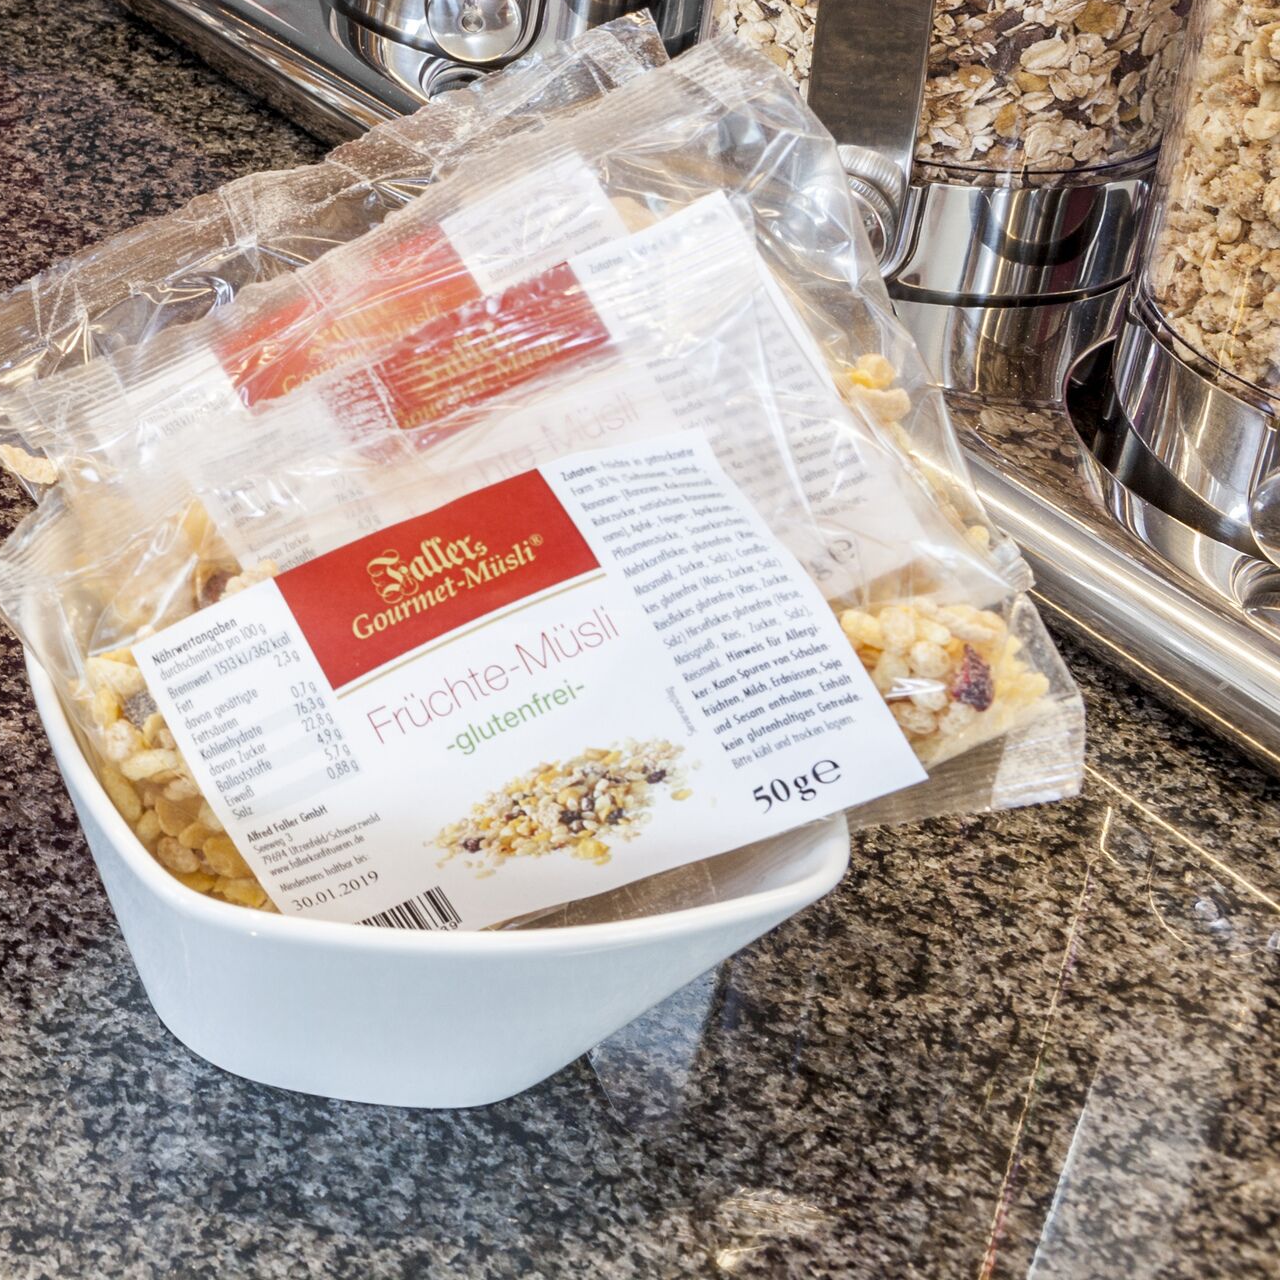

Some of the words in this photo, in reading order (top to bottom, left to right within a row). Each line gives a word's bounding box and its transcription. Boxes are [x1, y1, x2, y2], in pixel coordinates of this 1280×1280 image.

[366, 534, 489, 605] Fallers
[151, 619, 237, 666] Nährwertangaben
[160, 639, 225, 681] durchschnittlich
[224, 635, 241, 651] pro
[239, 623, 258, 640] 100
[725, 643, 765, 662] Hinweis
[765, 636, 781, 647] für
[273, 650, 292, 668] 2,3
[711, 675, 738, 691] Kann
[736, 661, 771, 680] Spuren
[772, 655, 790, 666] von
[167, 670, 213, 700] Brennwert
[214, 656, 238, 676] 1513
[290, 681, 306, 699] 0,7
[366, 606, 620, 744] Früchte-Müsli
[701, 695, 744, 717] früchten,
[742, 682, 768, 698] Milch,
[819, 659, 843, 671] Soja
[175, 699, 194, 714] Fett
[184, 711, 212, 730] davon
[293, 697, 317, 716] 76,3
[446, 678, 587, 757] -glutenfrei-
[713, 718, 732, 735] und
[732, 706, 766, 725] Sesam
[190, 718, 239, 745] Fettsäuren
[301, 712, 325, 733] 22,8
[317, 728, 332, 744] 4,9
[721, 737, 744, 752] kein
[746, 708, 816, 743] glutenhaltiges
[199, 726, 263, 761] Kohlenhydrate
[324, 743, 340, 761] 5,7
[774, 735, 792, 751] und
[209, 758, 237, 777] davon
[236, 743, 267, 763] Zucker
[326, 760, 350, 780] 0,88
[215, 759, 272, 793] Ballaststoffe
[232, 805, 254, 821] Salz
[247, 826, 274, 843] Alfred
[272, 818, 299, 833] Faller
[299, 805, 328, 822] GmbH
[292, 871, 378, 911] 30.01.2019
